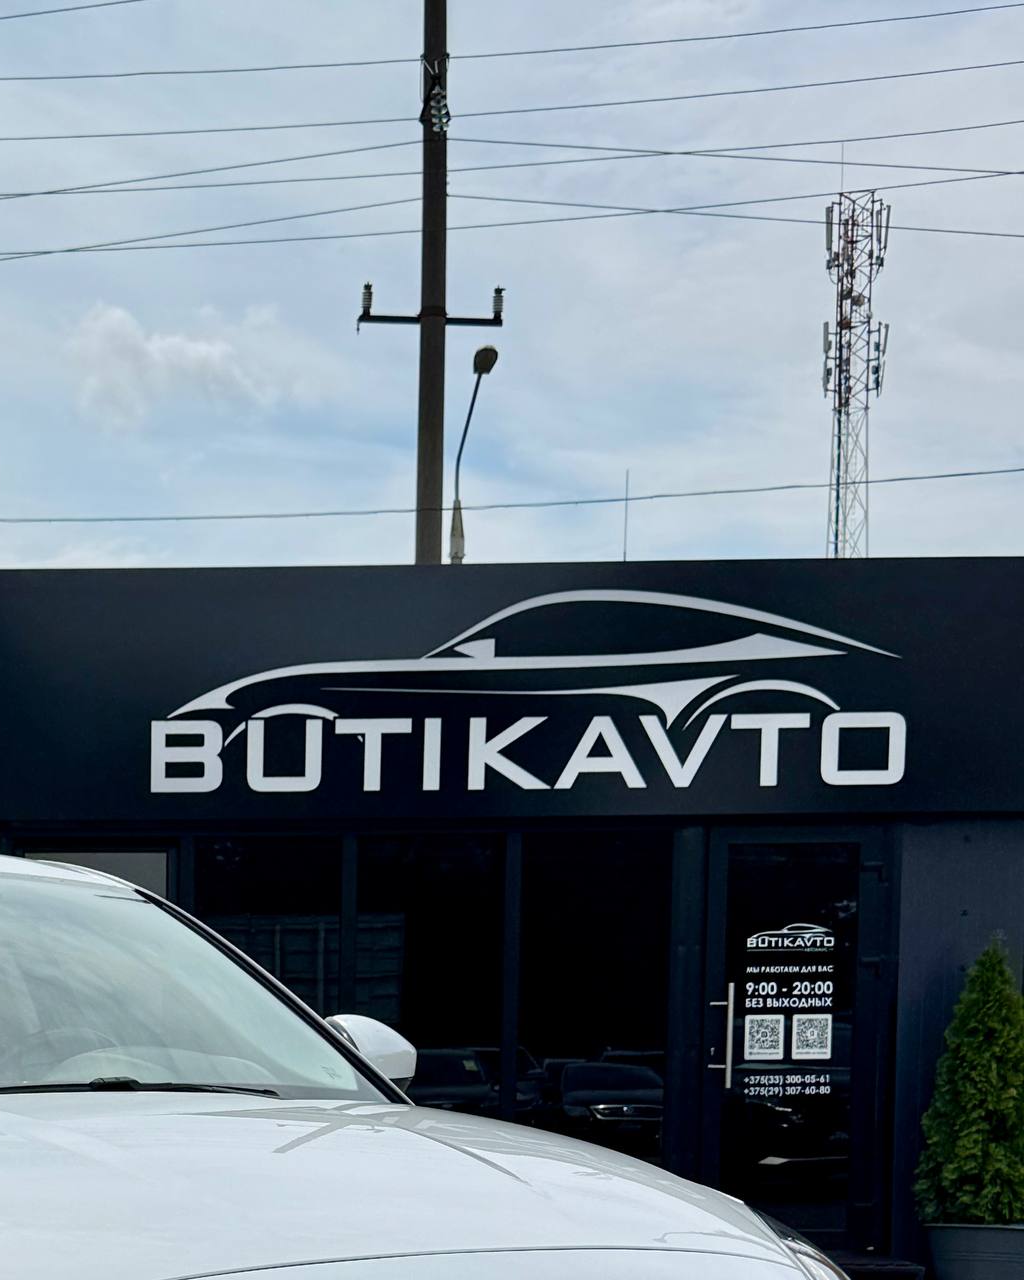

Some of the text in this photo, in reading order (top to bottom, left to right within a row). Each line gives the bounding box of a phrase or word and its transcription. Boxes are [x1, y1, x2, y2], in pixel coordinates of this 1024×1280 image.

[151, 712, 907, 793] BUTIKAVTO
[746, 937, 835, 948] BUTIKAVTO
[746, 965, 834, 974] МЫ РАБОТАЕМ ДЛЯ ВАС
[745, 982, 777, 995] 9:00
[792, 981, 833, 995] 20:00
[745, 997, 833, 1008] БЕЗ ВЫХОДНЫХ
[743, 1074, 830, 1085] +375(33) 300-05-61
[743, 1086, 831, 1097] +375(29) 307-60-80
